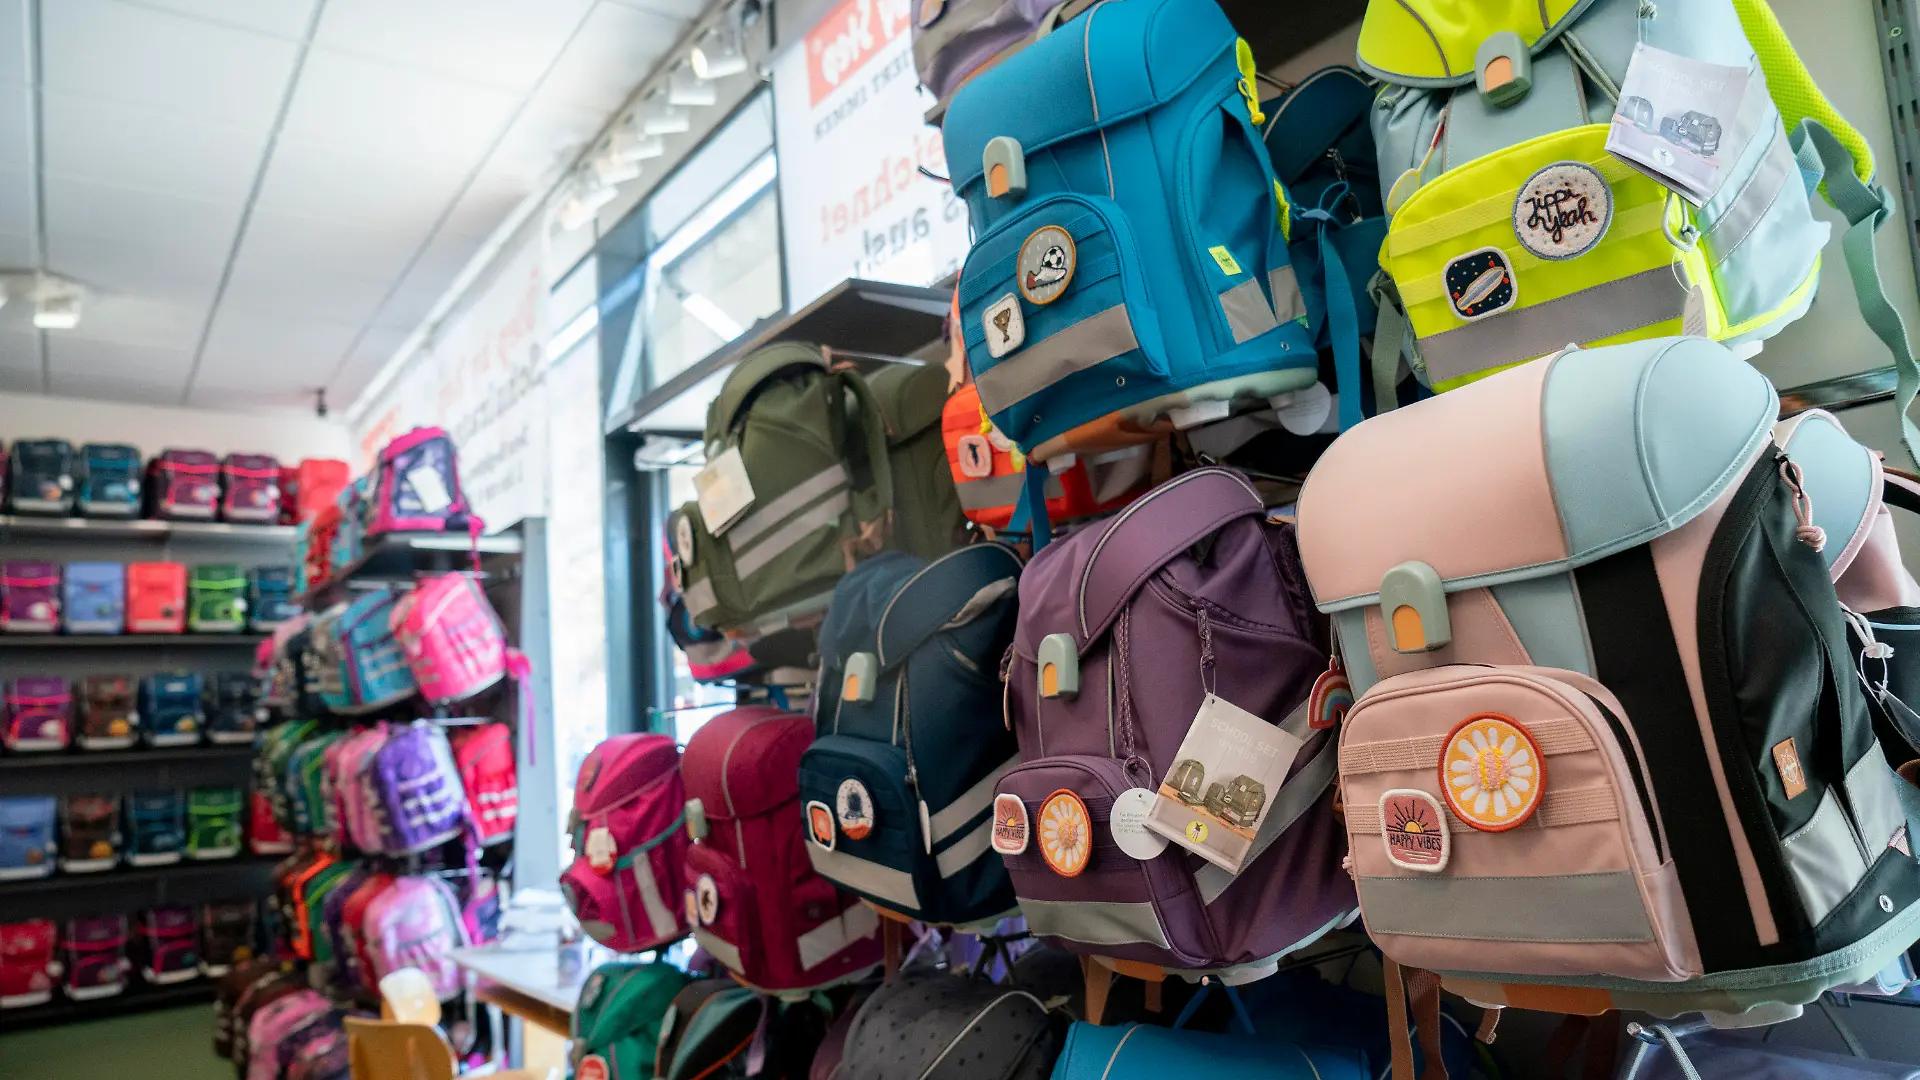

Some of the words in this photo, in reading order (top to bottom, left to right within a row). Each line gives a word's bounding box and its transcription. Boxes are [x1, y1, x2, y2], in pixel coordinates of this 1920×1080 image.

[1210, 716, 1254, 748] SCHOOL
[1255, 741, 1280, 758] SET
[1391, 834, 1414, 849] HAPPY
[1417, 835, 1442, 851] VIBES
